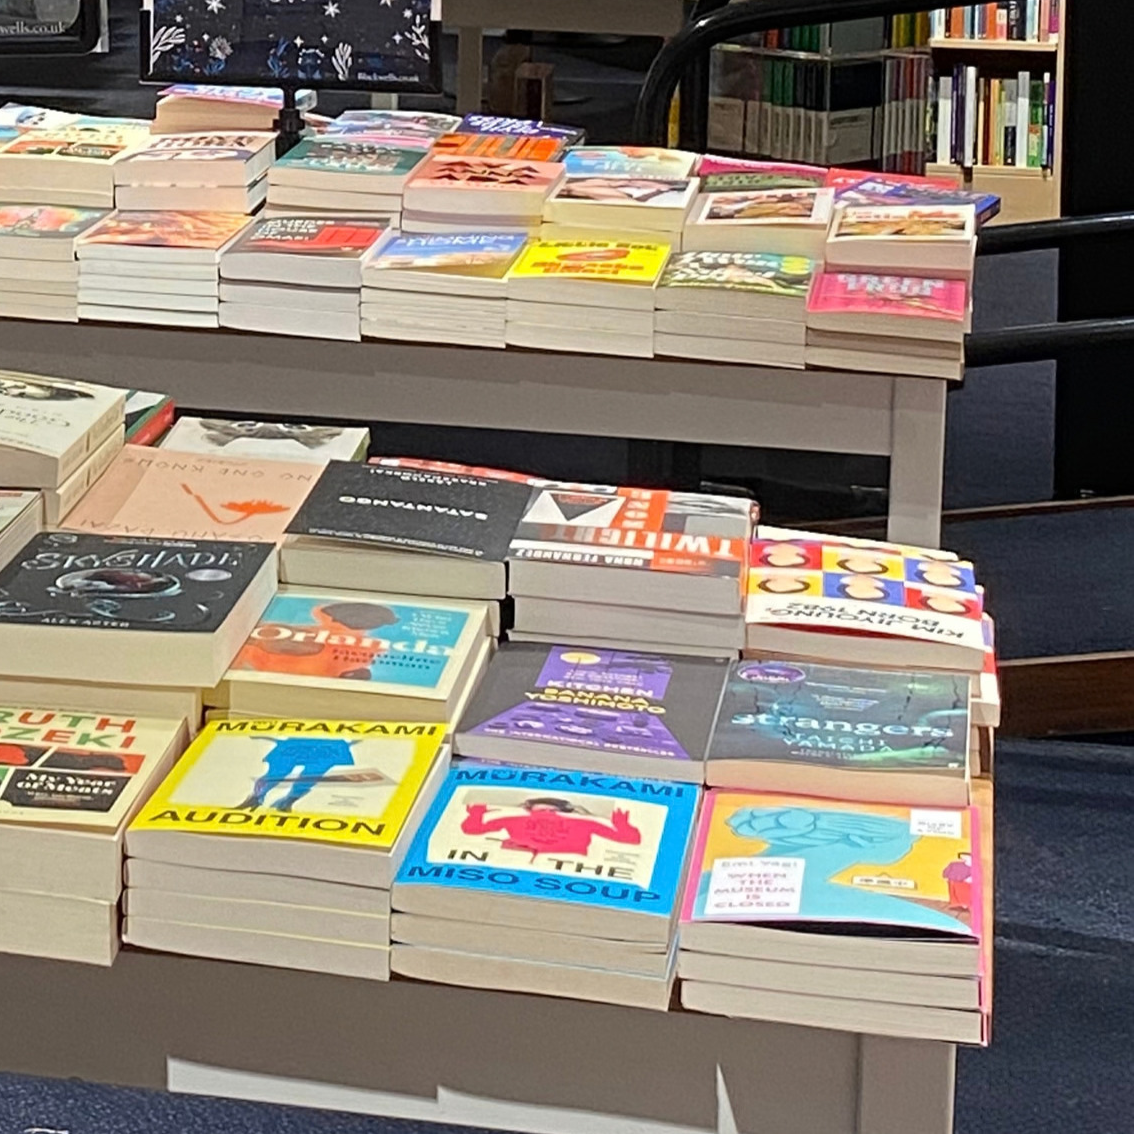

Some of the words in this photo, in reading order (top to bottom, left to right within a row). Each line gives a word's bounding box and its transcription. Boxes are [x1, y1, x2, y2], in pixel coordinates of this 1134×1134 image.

[280, 473, 313, 483] NO
[339, 495, 488, 521] SATANTANGO
[547, 524, 734, 558] TWILIGHT
[856, 608, 940, 627] BORN
[250, 625, 455, 657] Orlanda
[911, 623, 964, 639] KIM
[543, 688, 650, 706] BANANA
[547, 679, 654, 699] KITCHEN
[524, 692, 668, 715] YOSHIMOTO
[216, 721, 437, 737] MURAKAMI
[731, 713, 954, 738] strangers
[783, 738, 894, 752] YAMADA
[454, 769, 684, 798] MURAKAMI
[148, 809, 387, 837] AUDITION
[446, 849, 489, 863] IN
[548, 857, 636, 881] THE
[407, 865, 520, 885] MISO
[534, 877, 661, 904] SOUP
